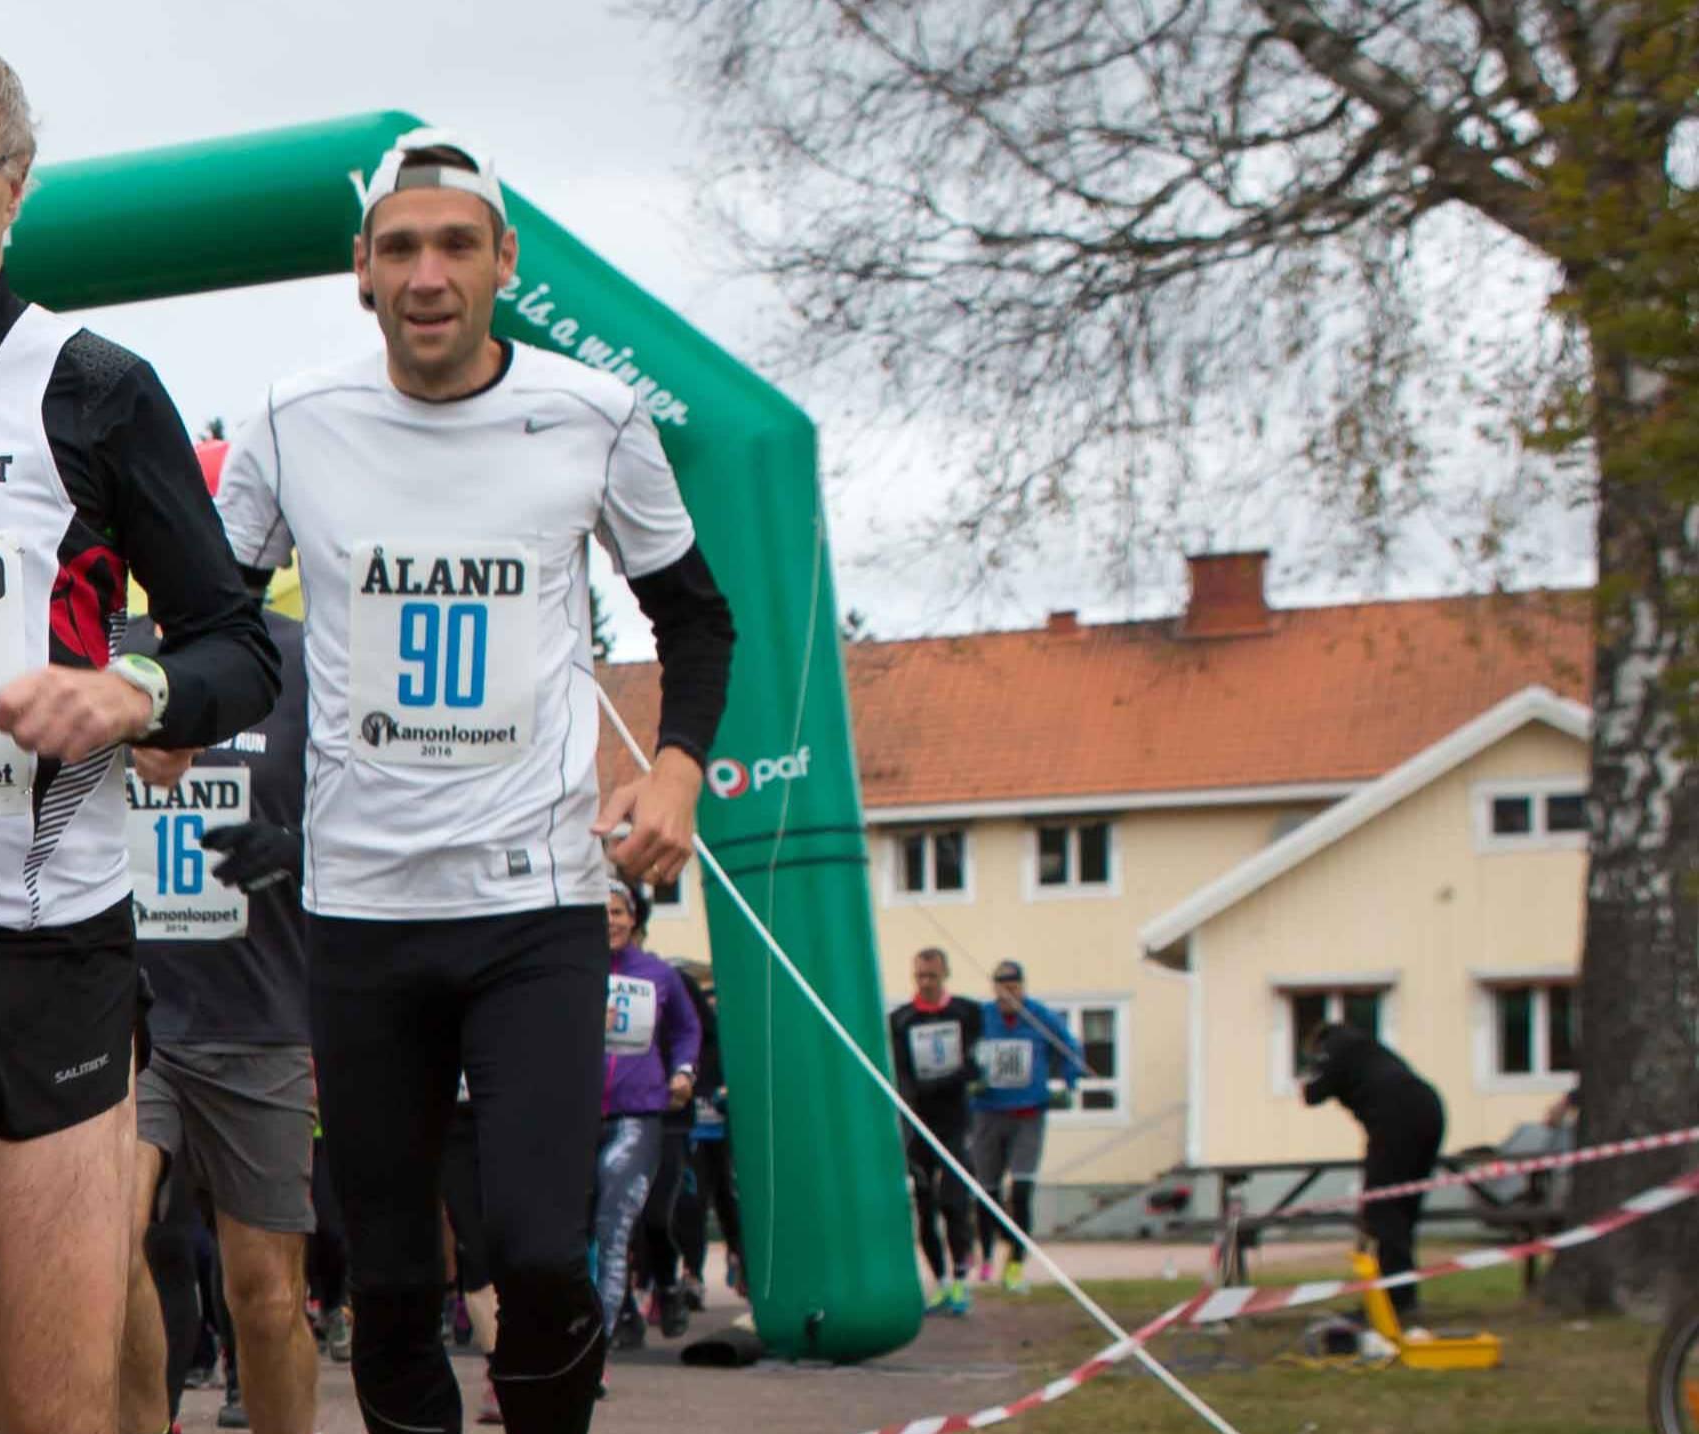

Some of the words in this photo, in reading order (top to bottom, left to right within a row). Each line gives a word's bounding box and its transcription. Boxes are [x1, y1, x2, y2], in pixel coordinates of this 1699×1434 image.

[550, 318, 580, 347] a
[577, 336, 689, 426] winner
[361, 545, 525, 596] ÅLAND
[398, 602, 488, 708] 90
[391, 723, 516, 746] Kanonloppet
[421, 746, 452, 758] 2016
[753, 745, 811, 792] paf
[154, 814, 205, 896] 16
[141, 905, 239, 923] Kanonloppet
